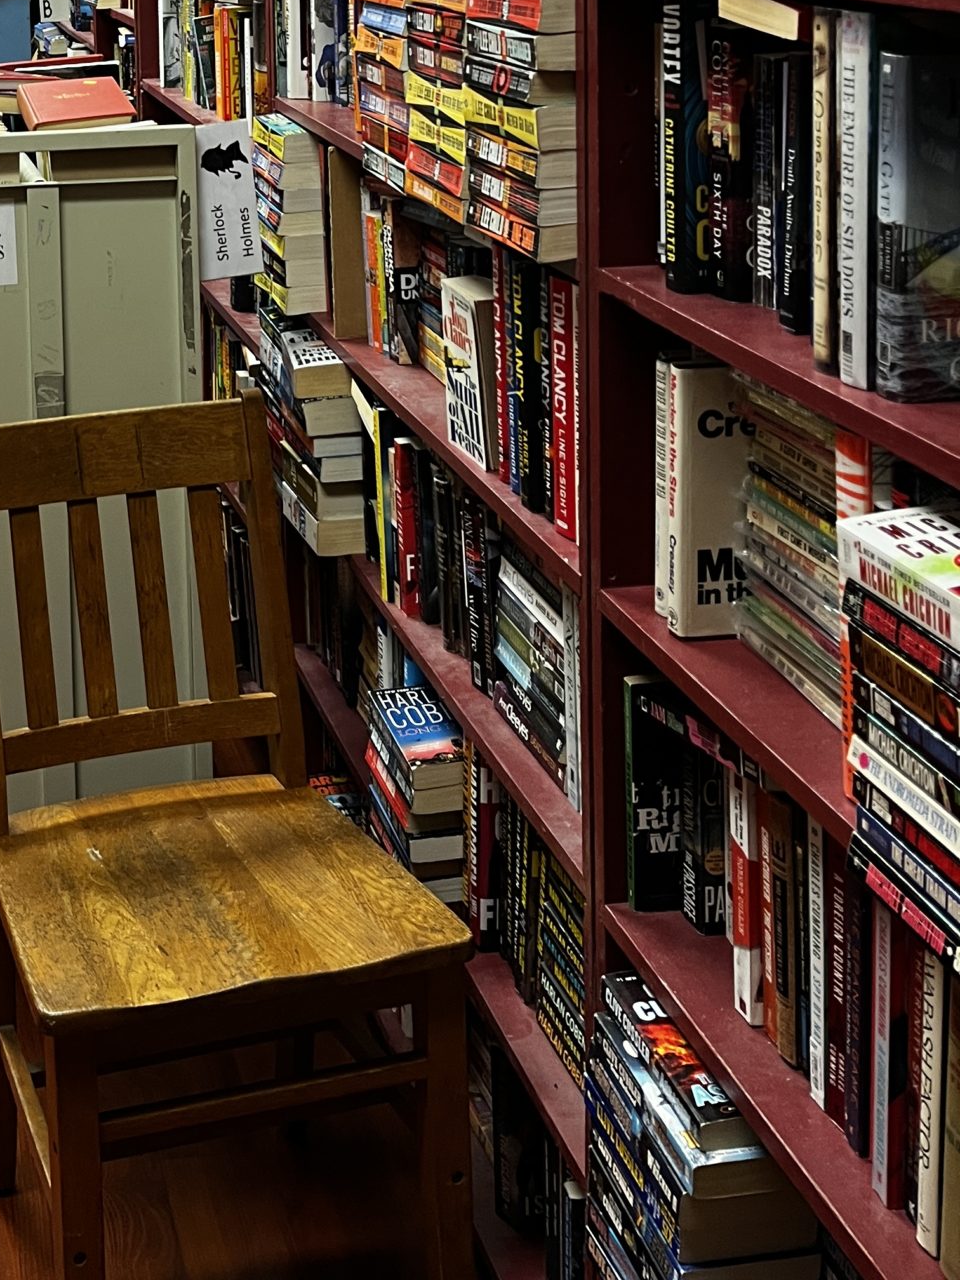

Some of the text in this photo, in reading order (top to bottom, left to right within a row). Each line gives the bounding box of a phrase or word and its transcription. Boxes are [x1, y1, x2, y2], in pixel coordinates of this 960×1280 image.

[43, 0, 52, 18] B
[663, 4, 681, 86] VORTEX
[475, 99, 483, 116] LEE
[665, 118, 674, 194] CATHERINE
[713, 173, 722, 259] SIXTH DAY
[842, 65, 855, 318] THE EMPIRE OF SHADOWS
[881, 161, 893, 217] GATE
[211, 204, 230, 261] Sherlock
[235, 207, 254, 257] Holmes
[757, 205, 771, 279] PARADOX
[783, 148, 796, 296] Death Awaits Durham
[385, 225, 395, 293] DUKKHA
[443, 320, 473, 359] Clancy
[450, 294, 468, 337] Tom
[512, 275, 525, 403] TOM CLANCY
[446, 371, 478, 407] Sum
[464, 372, 476, 390] The
[539, 281, 552, 498] TOM CLANCY POINT
[551, 291, 567, 518] TOM CLANCY LINE OF SIGHT
[450, 417, 484, 464] Fears
[509, 436, 517, 475] HONOR
[522, 429, 530, 475] TARGET
[669, 373, 677, 518] Murder in the Stars
[464, 510, 476, 584] ANN CLEEVES
[512, 570, 535, 606] Cleeves
[859, 556, 900, 606] MICHAEL
[903, 581, 952, 640] CRICHTON
[506, 702, 529, 742] Cleeves
[868, 721, 936, 796] MICHAEL CRICHTON
[470, 763, 478, 830] HARLAN
[882, 768, 959, 845] ANDROMEDA STRAIN
[683, 862, 695, 923] PASSAGE
[809, 842, 823, 898] CHARLES
[833, 886, 844, 1005] FOREIGN COUNTRY
[540, 968, 566, 1018] HARLAN
[538, 1008, 564, 1054] HARLAN
[605, 989, 651, 1066] CLIVE CUSSLER
